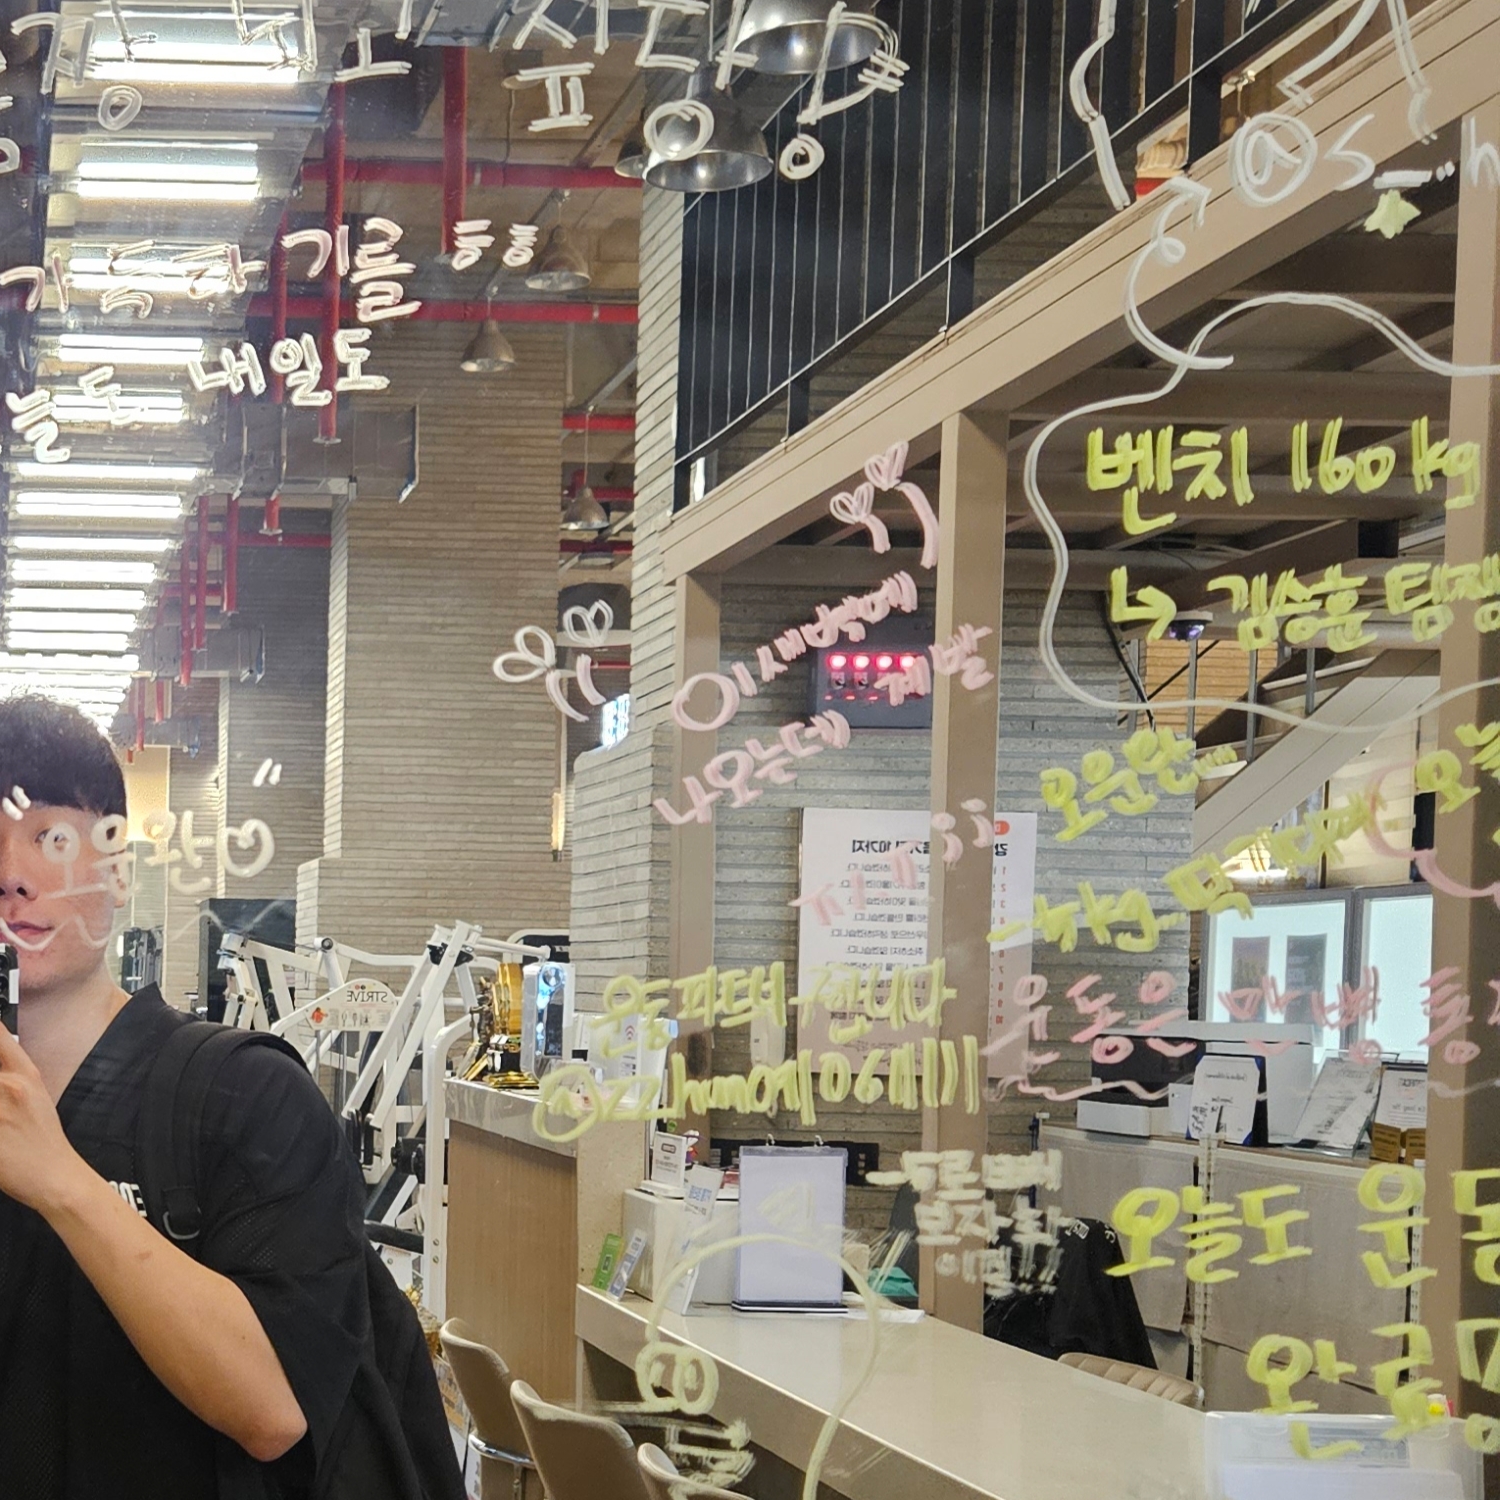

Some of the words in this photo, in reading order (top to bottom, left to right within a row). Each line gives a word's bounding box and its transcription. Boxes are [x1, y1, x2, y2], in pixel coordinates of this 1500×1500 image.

[187, 327, 392, 408] 내일도
[1086, 424, 1254, 536] 벤치
[1291, 415, 1397, 495] 160
[1411, 415, 1481, 510] kg
[1105, 1184, 1313, 1285] 오늘도
